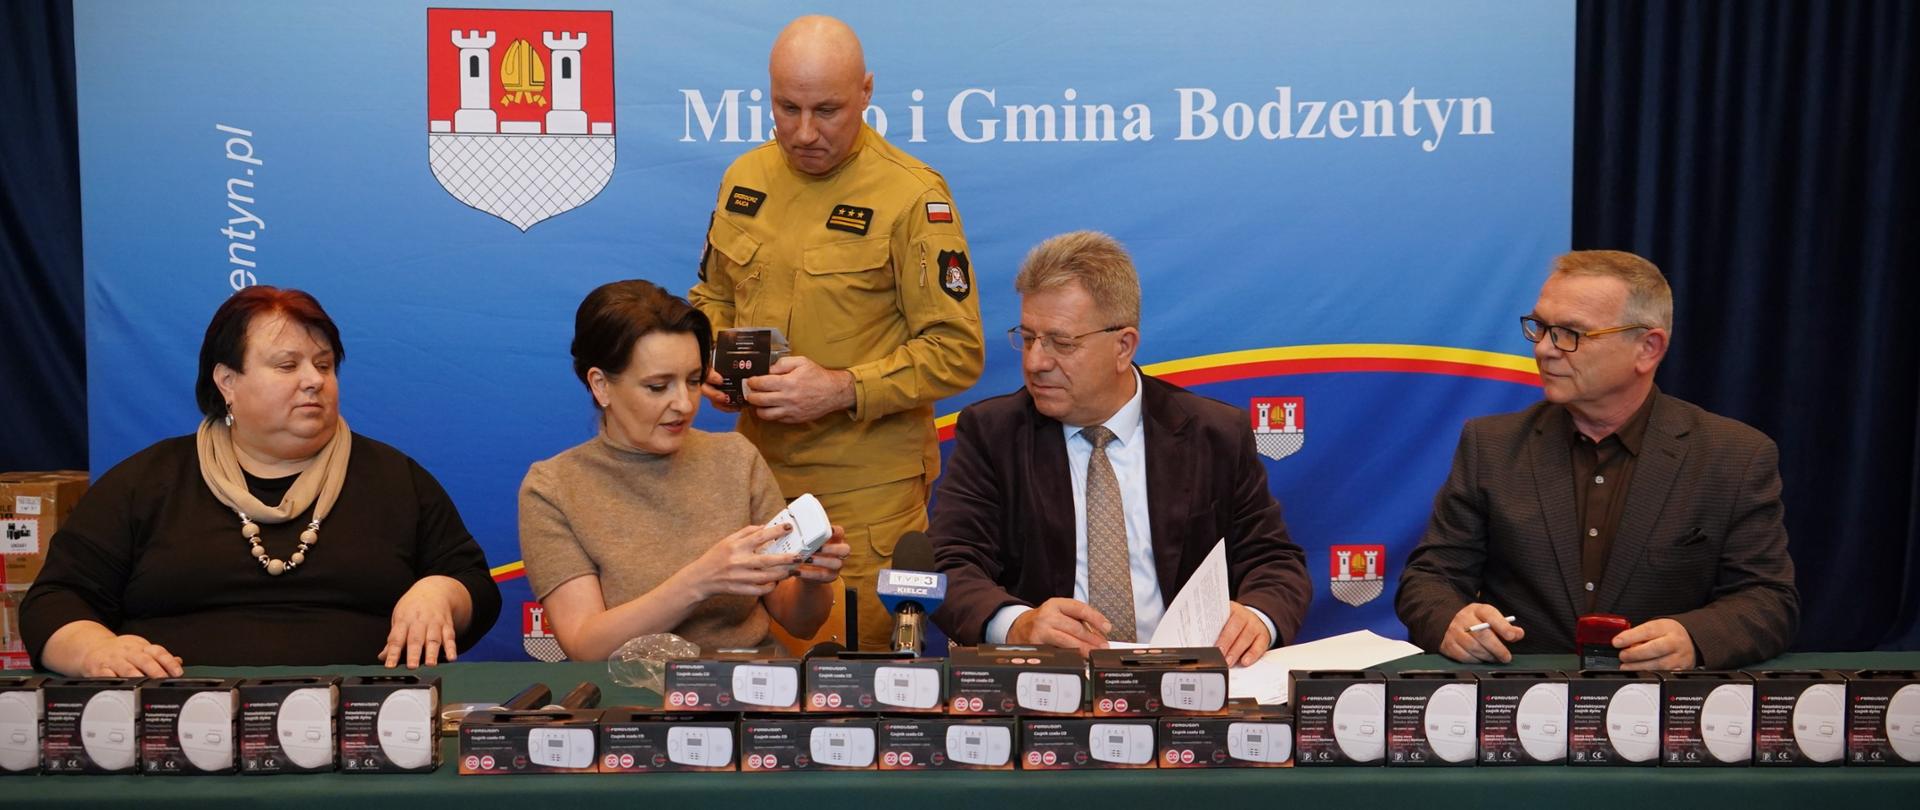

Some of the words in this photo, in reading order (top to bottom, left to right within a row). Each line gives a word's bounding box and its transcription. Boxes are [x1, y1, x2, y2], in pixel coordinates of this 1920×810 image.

[678, 88, 888, 143] Mio
[909, 88, 927, 143] i
[947, 88, 1155, 143] Gmina
[1174, 86, 1495, 152] Bodzentyn
[216, 123, 265, 295] entyn.pl
